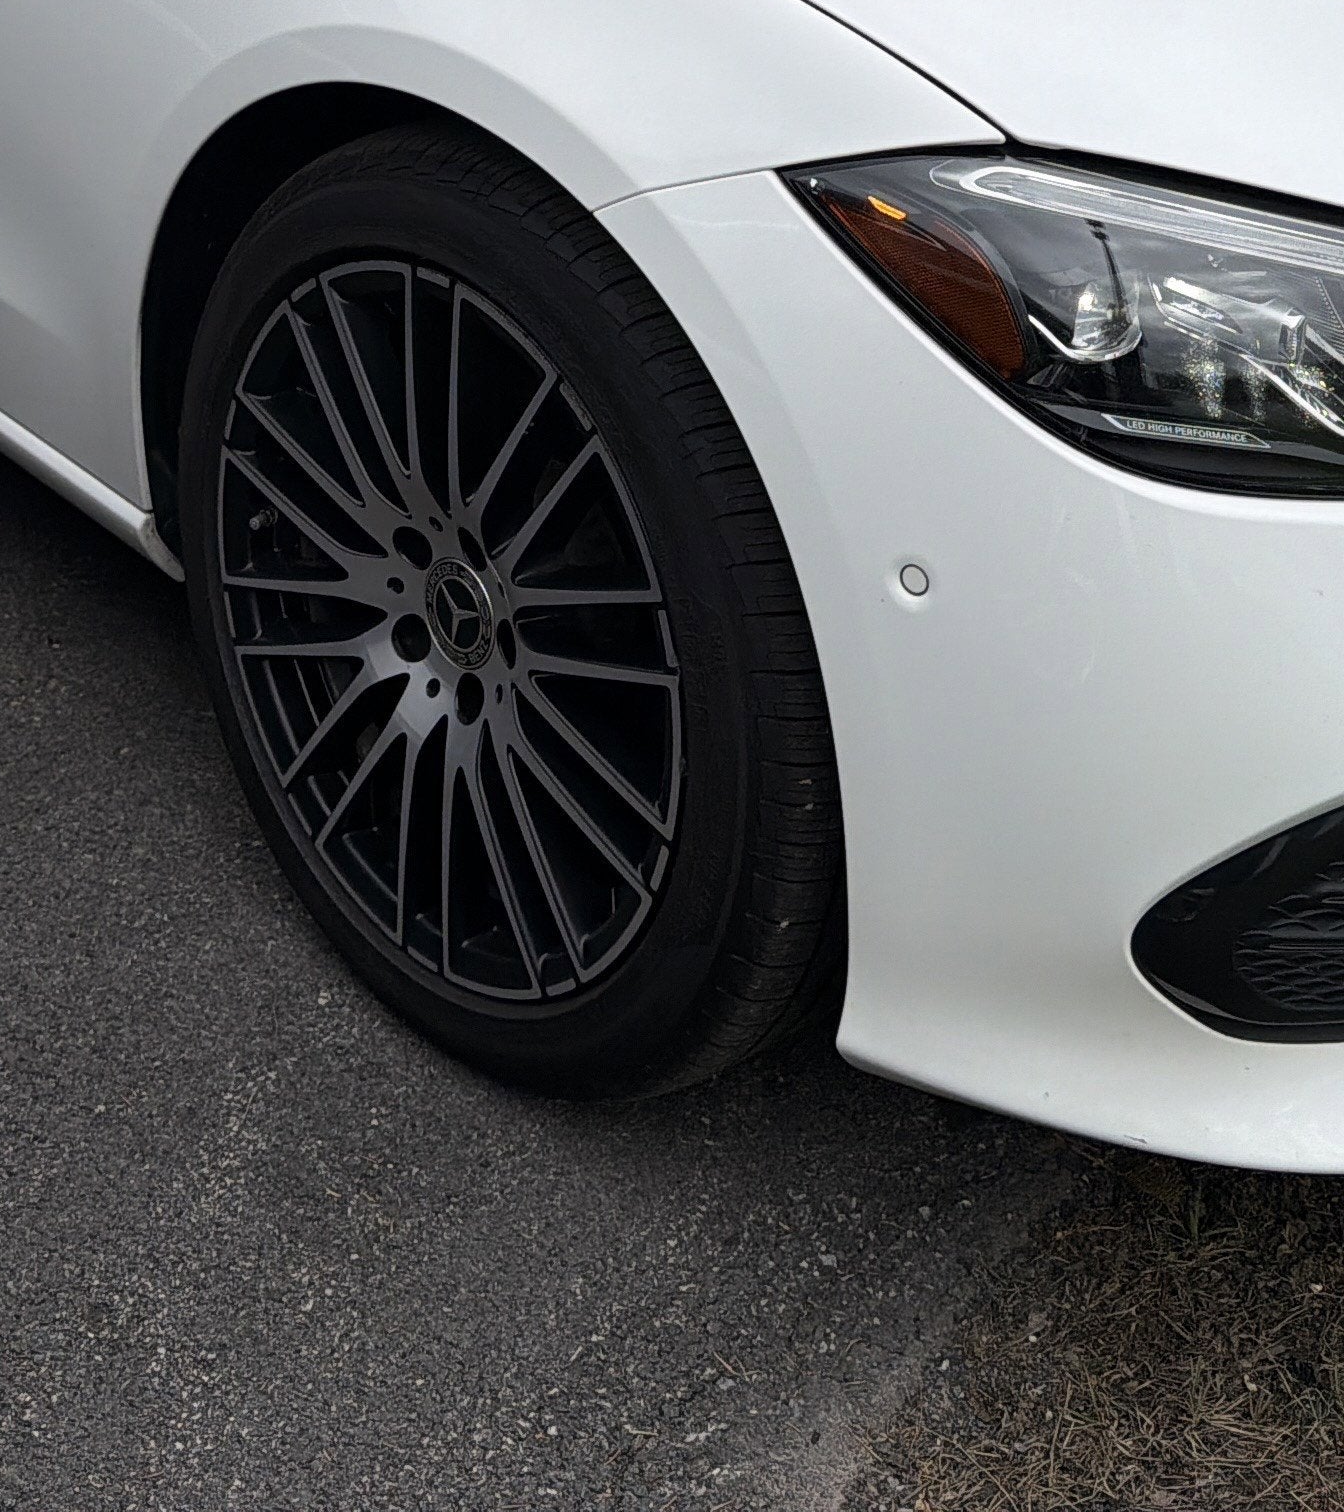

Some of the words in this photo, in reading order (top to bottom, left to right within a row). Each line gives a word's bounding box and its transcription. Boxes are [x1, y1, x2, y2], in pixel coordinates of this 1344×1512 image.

[1126, 419, 1146, 430] LED
[1148, 422, 1173, 434] HIGH
[1174, 426, 1248, 443] PERFORMANCE
